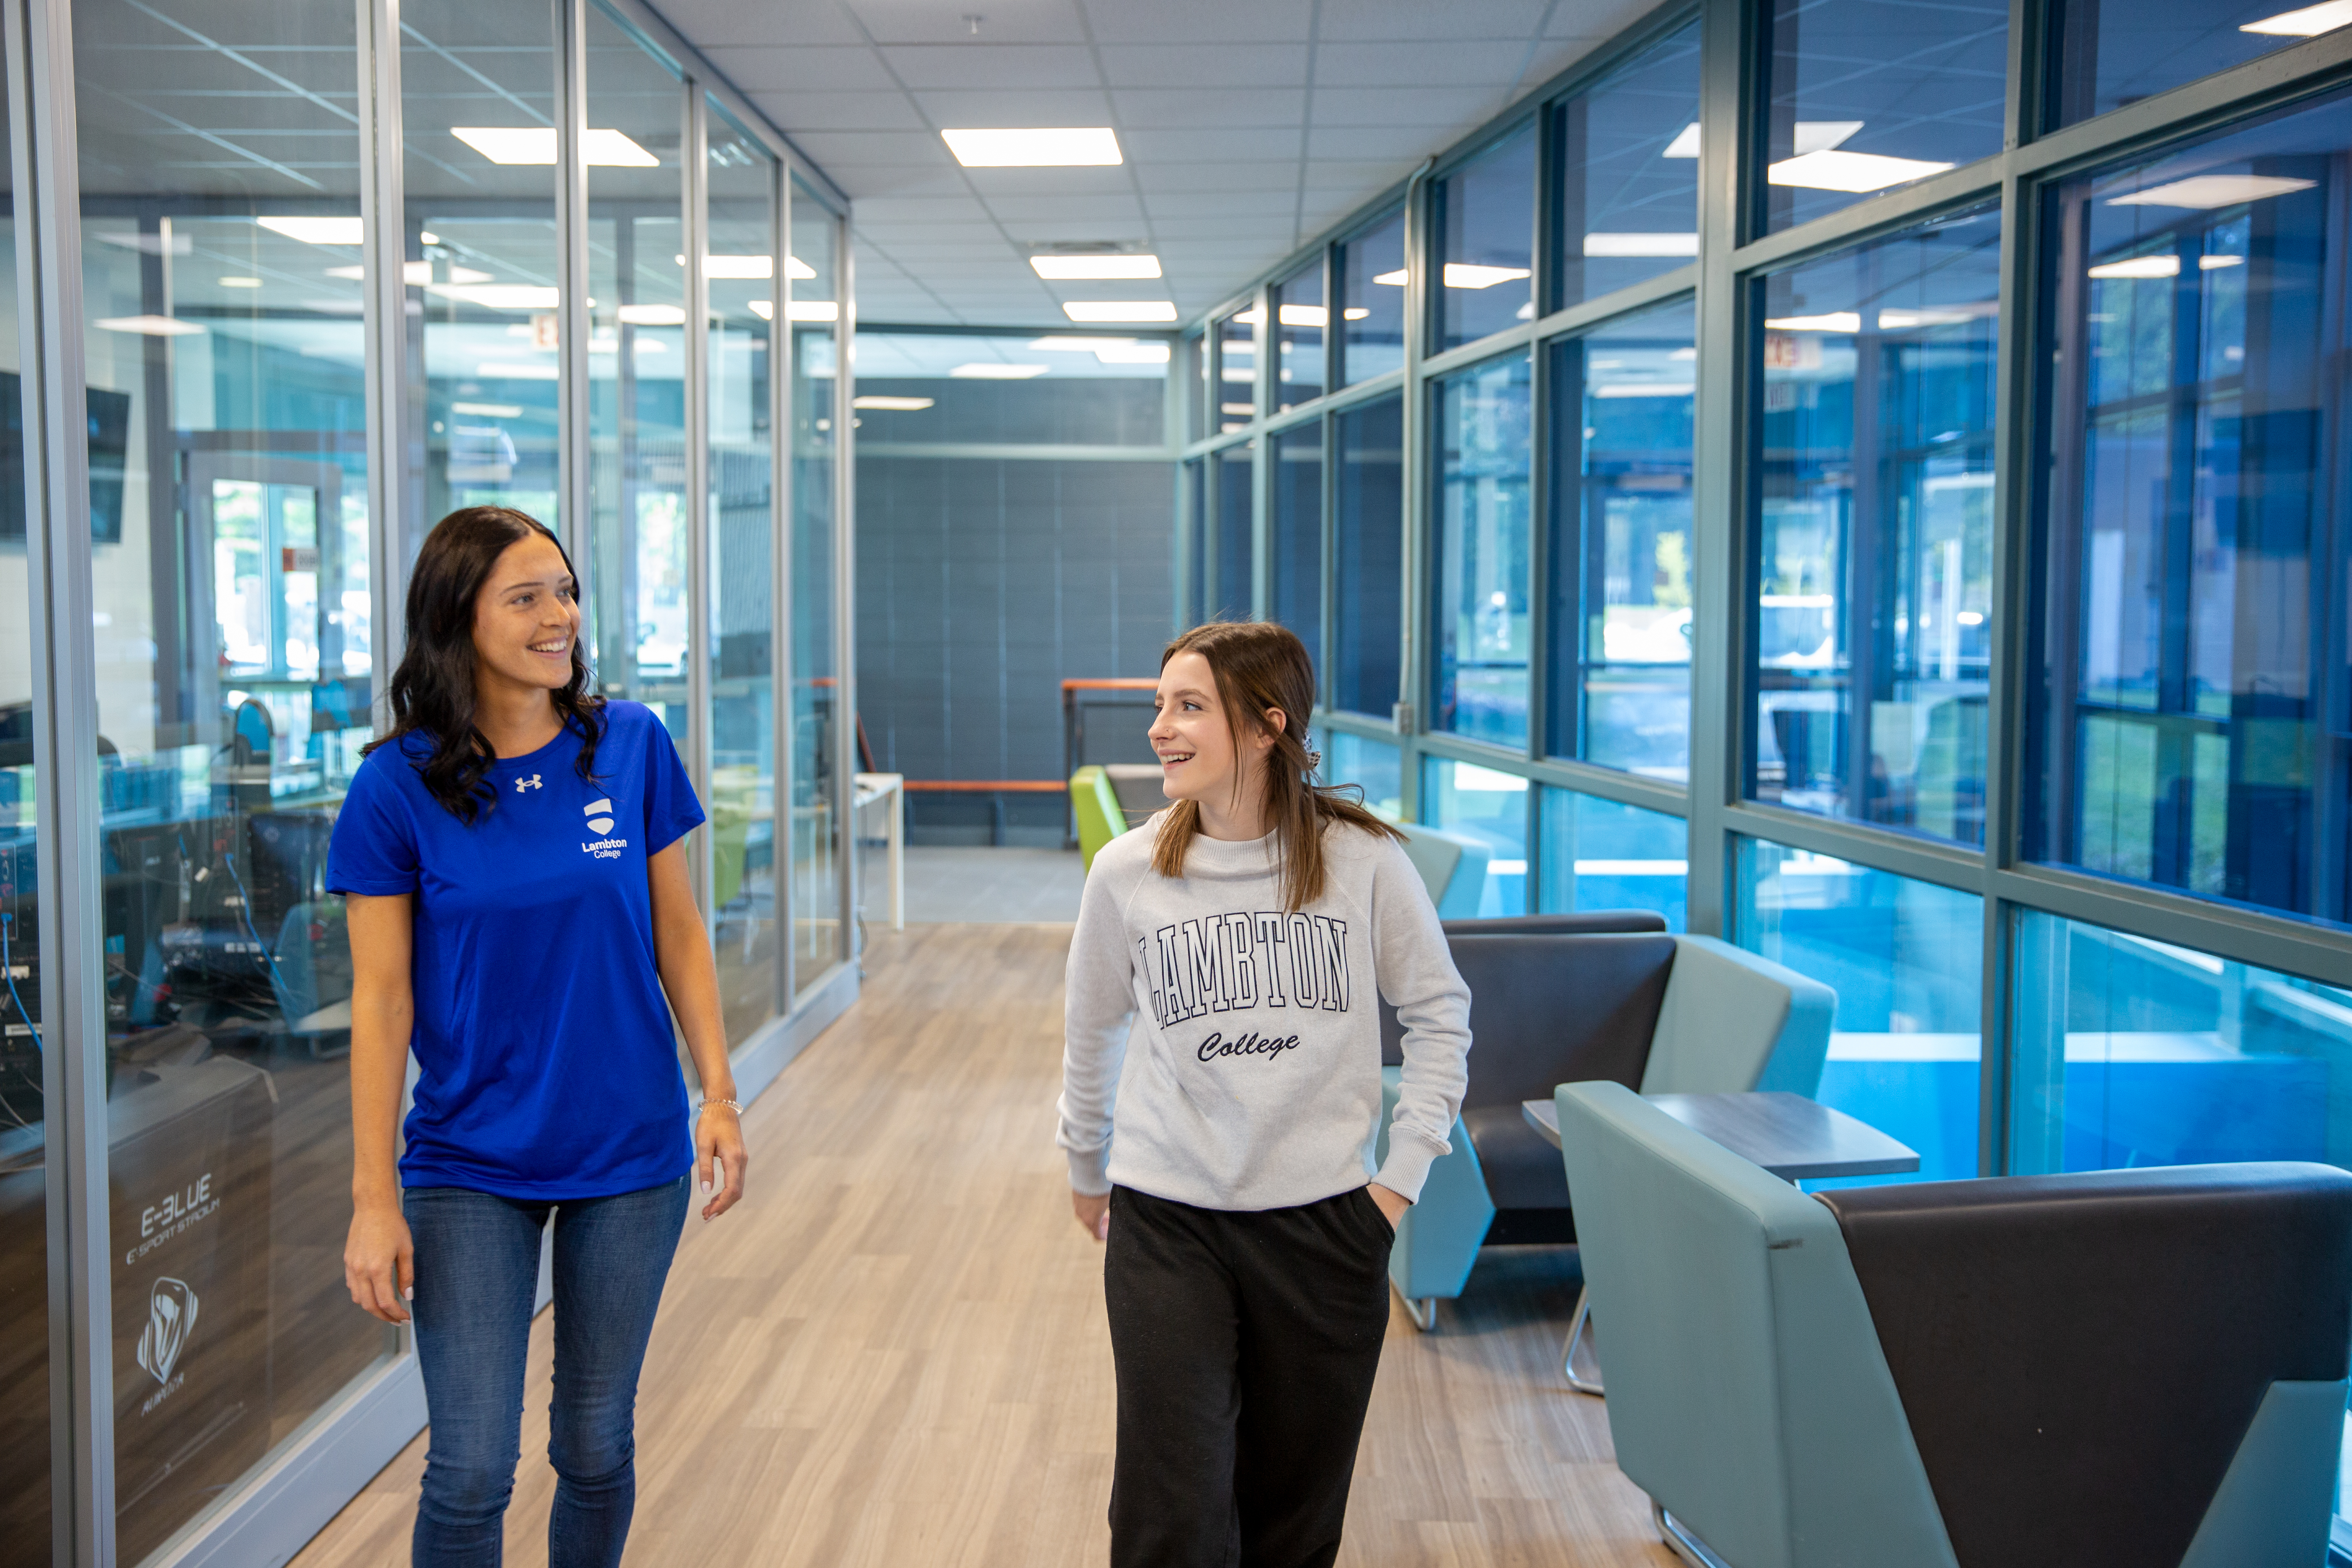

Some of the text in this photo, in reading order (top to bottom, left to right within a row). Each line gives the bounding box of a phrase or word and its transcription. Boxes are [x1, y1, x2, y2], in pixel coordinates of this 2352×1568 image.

[582, 838, 627, 853] Lambton
[594, 849, 621, 859] College
[1139, 911, 1349, 1030] LAMBTON
[1197, 1032, 1300, 1062] College
